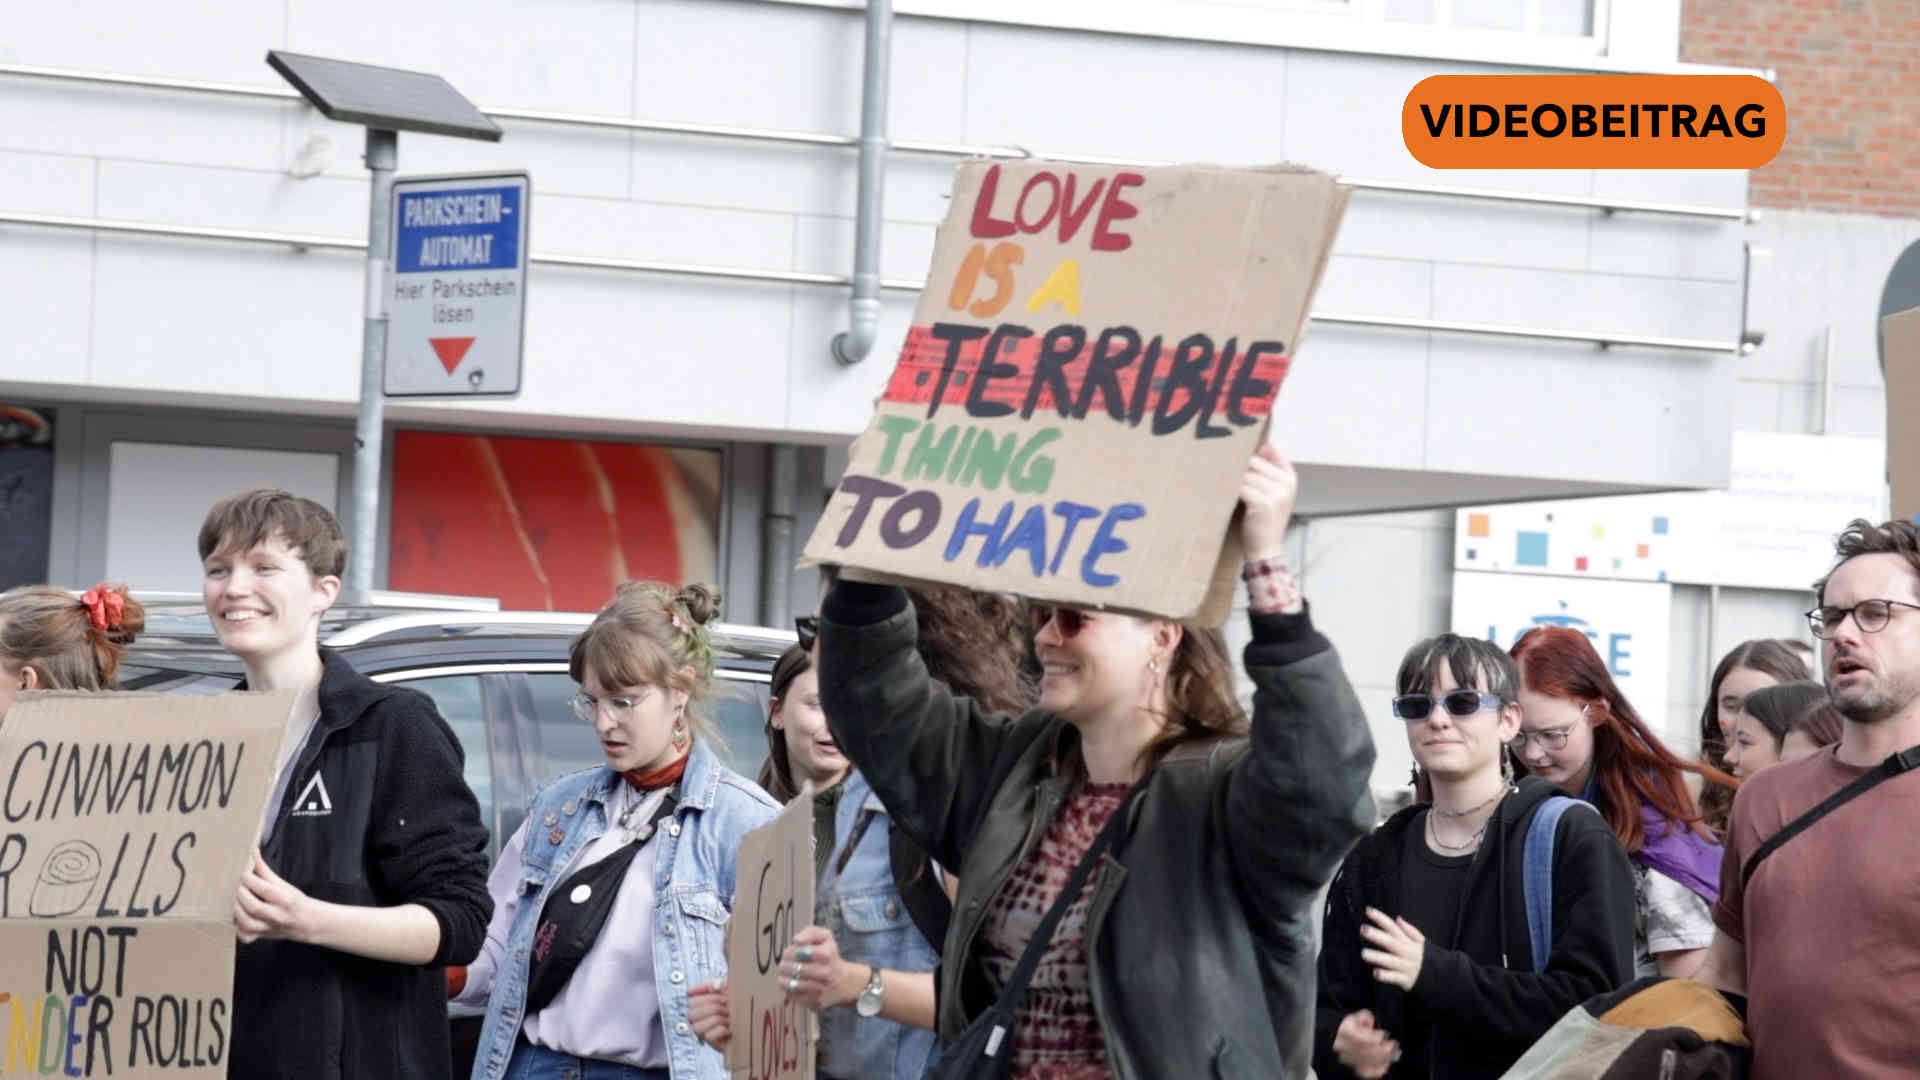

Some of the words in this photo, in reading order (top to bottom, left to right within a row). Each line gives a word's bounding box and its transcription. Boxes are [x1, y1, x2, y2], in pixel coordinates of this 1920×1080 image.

[404, 194, 513, 228] PARKSCHEIN-
[970, 164, 1145, 252] LOVE
[419, 234, 494, 267] AUTOMAT
[948, 241, 1025, 319] IS
[1026, 258, 1082, 317] A
[395, 280, 426, 300] Hier
[432, 278, 516, 298] Parkschein
[432, 304, 474, 324] lösen
[926, 321, 1285, 439] TERRIBLE
[875, 416, 1063, 494] THING
[835, 475, 942, 550] TO
[943, 497, 1146, 588] HATE
[4, 740, 244, 822] CINNAMON
[46, 926, 137, 998] NOT
[129, 995, 226, 1069] ROLLS
